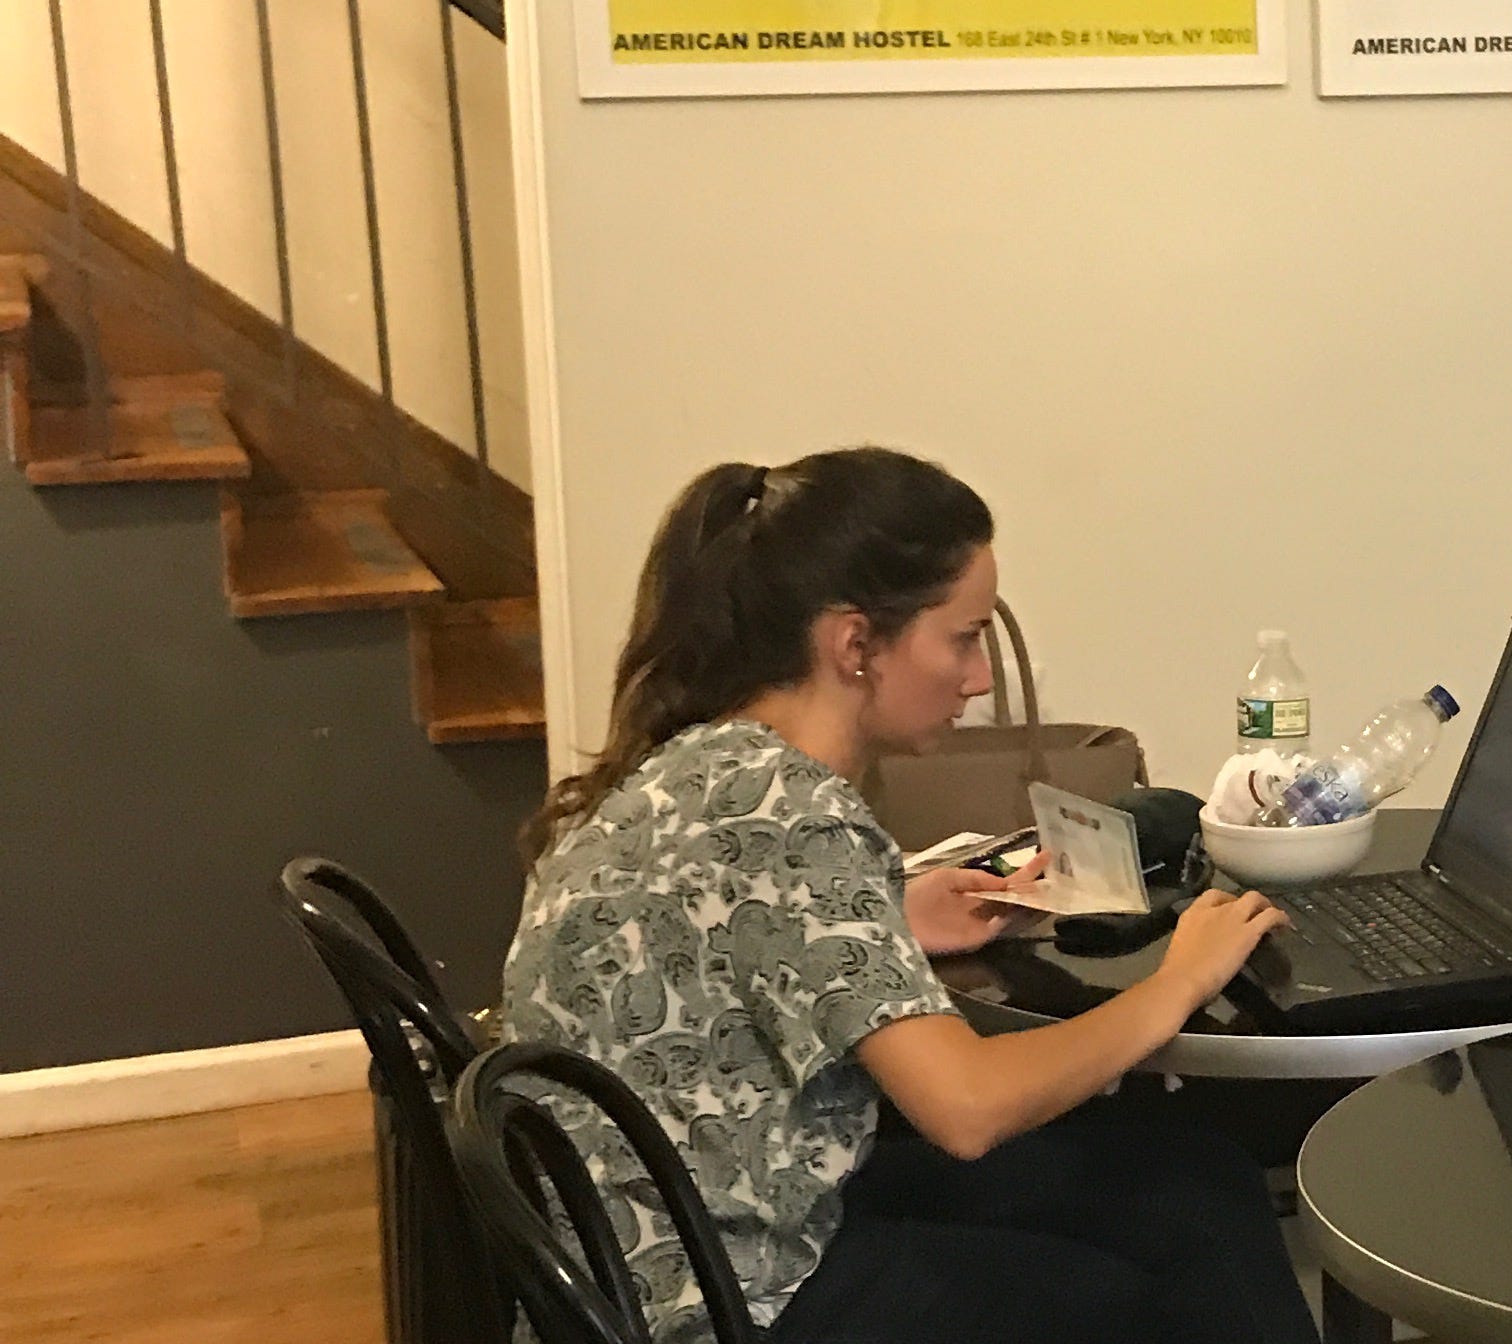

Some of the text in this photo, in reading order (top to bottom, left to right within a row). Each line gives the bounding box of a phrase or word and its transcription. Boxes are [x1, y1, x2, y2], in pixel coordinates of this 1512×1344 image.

[613, 32, 749, 51] AMERICAN
[757, 31, 846, 50] DREAM
[853, 30, 952, 49] HOSTEL
[1107, 28, 1140, 45] New
[1182, 27, 1205, 44] NY
[1352, 36, 1467, 55] AMERICAN
